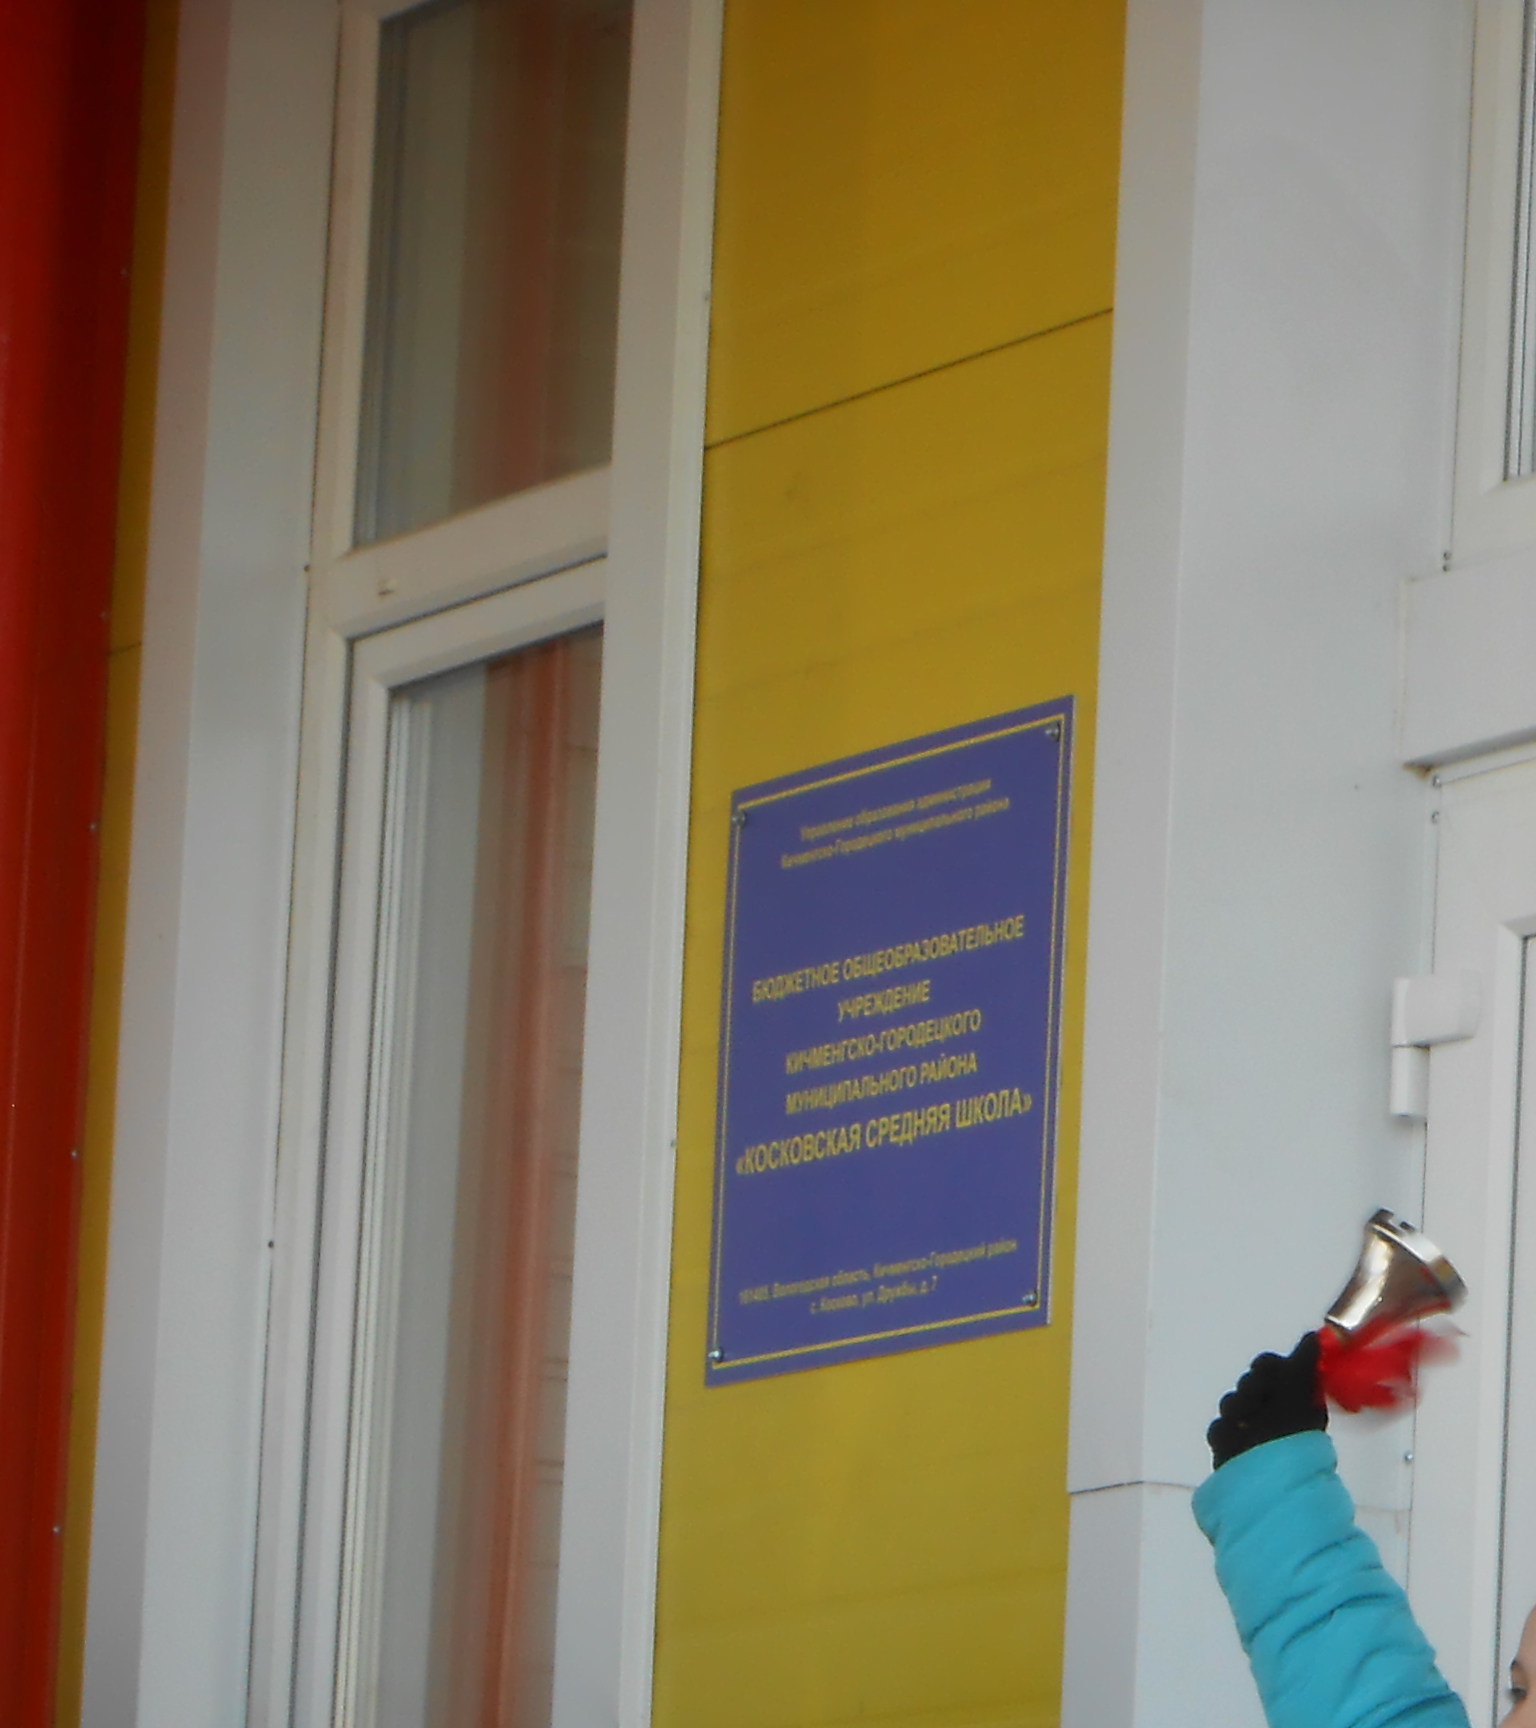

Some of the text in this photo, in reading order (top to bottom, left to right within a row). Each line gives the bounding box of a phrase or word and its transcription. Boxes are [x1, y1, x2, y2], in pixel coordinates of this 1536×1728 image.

[753, 915, 1024, 1003] БЮДЖЕТНОЕ ОБЩЕОБРАЗОВАТЕЛЬНОЕ
[838, 980, 930, 1021] УЧРЕЖДЕНИЕ
[786, 1009, 981, 1074] КИЧМЕНГСКО-ГОРОДЕЦКОГО
[786, 1053, 978, 1114] МУНИЦИПАЛЬНОГО РАЙОНА
[736, 1088, 1032, 1174] «КОСКОВСКАЯ СРЕДНЯЯ ШКОЛА»
